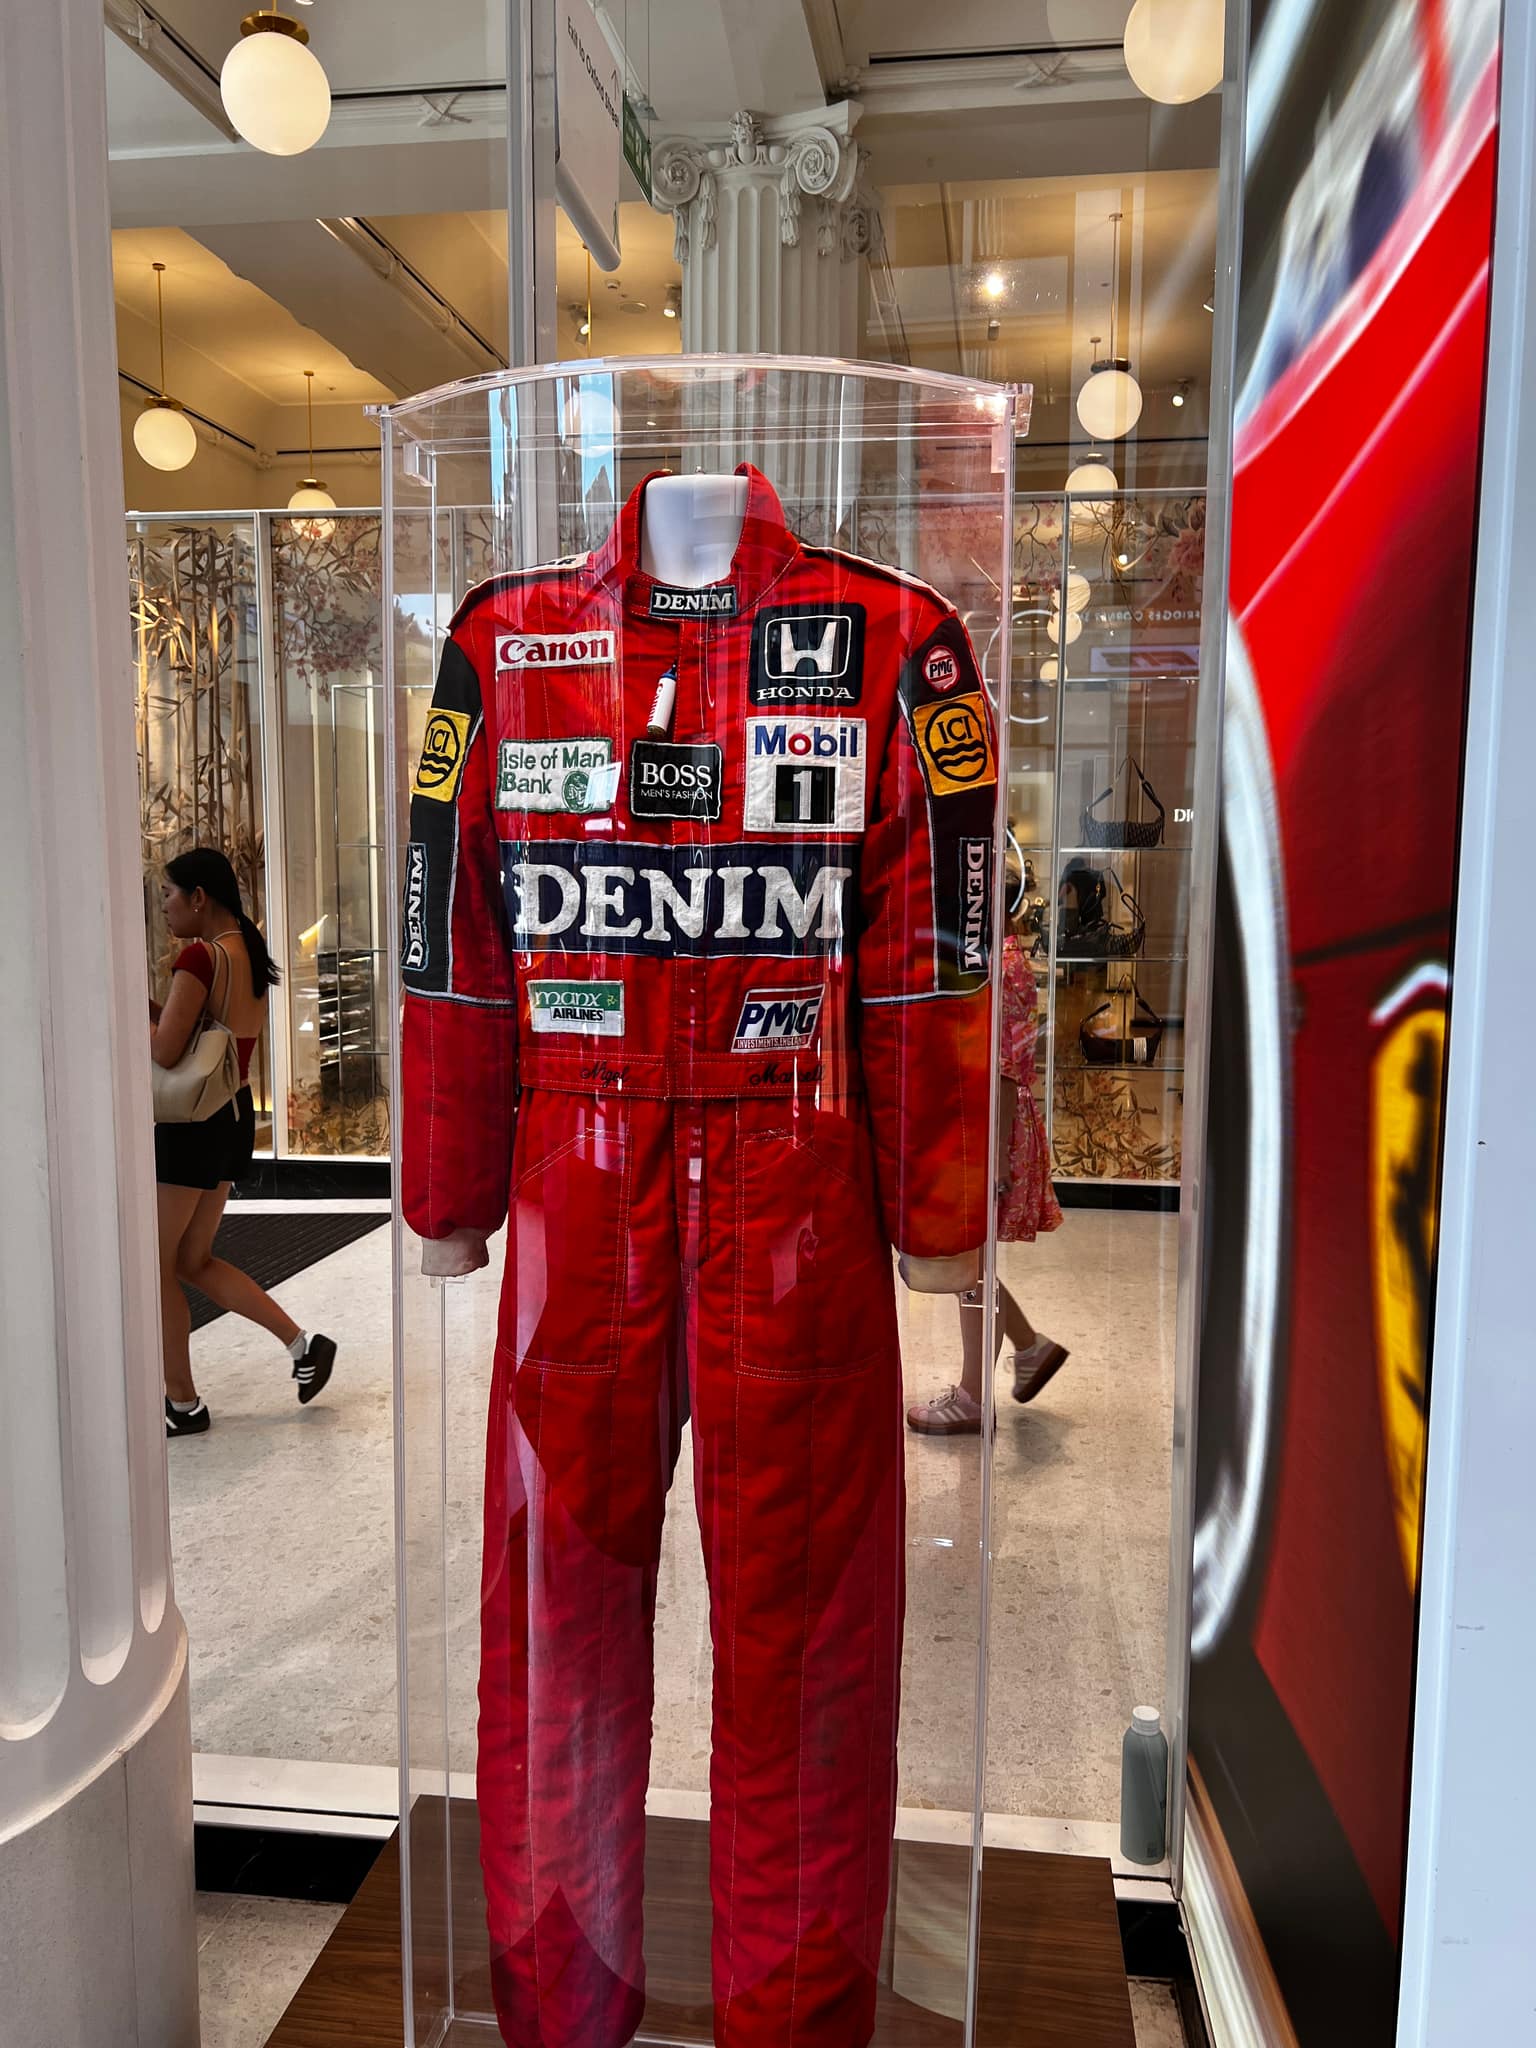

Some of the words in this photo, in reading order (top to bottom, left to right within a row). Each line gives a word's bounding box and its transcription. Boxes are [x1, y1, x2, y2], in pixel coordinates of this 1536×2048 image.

[652, 590, 734, 610] DENIM
[499, 637, 609, 664] Canon
[929, 658, 953, 678] PMG
[756, 685, 855, 700] HONDA
[427, 727, 450, 754] ICI
[754, 723, 858, 757] Mobil
[937, 715, 973, 745] ICI
[503, 747, 536, 770] Isle
[540, 748, 558, 770] of
[562, 747, 604, 768] Man
[501, 771, 551, 794] Bank
[641, 763, 712, 788] BOSS
[641, 788, 670, 799] MEN'S
[672, 790, 712, 801] FASHION
[792, 769, 812, 821] 1
[1174, 808, 1194, 823] DI
[406, 848, 424, 967] DENIM
[512, 864, 853, 942] DENIM
[965, 842, 985, 969] DENIM
[535, 991, 603, 1007] manx
[552, 1008, 603, 1021] AIRLINES
[737, 1000, 821, 1037] PMG
[581, 1060, 631, 1088] Nigel
